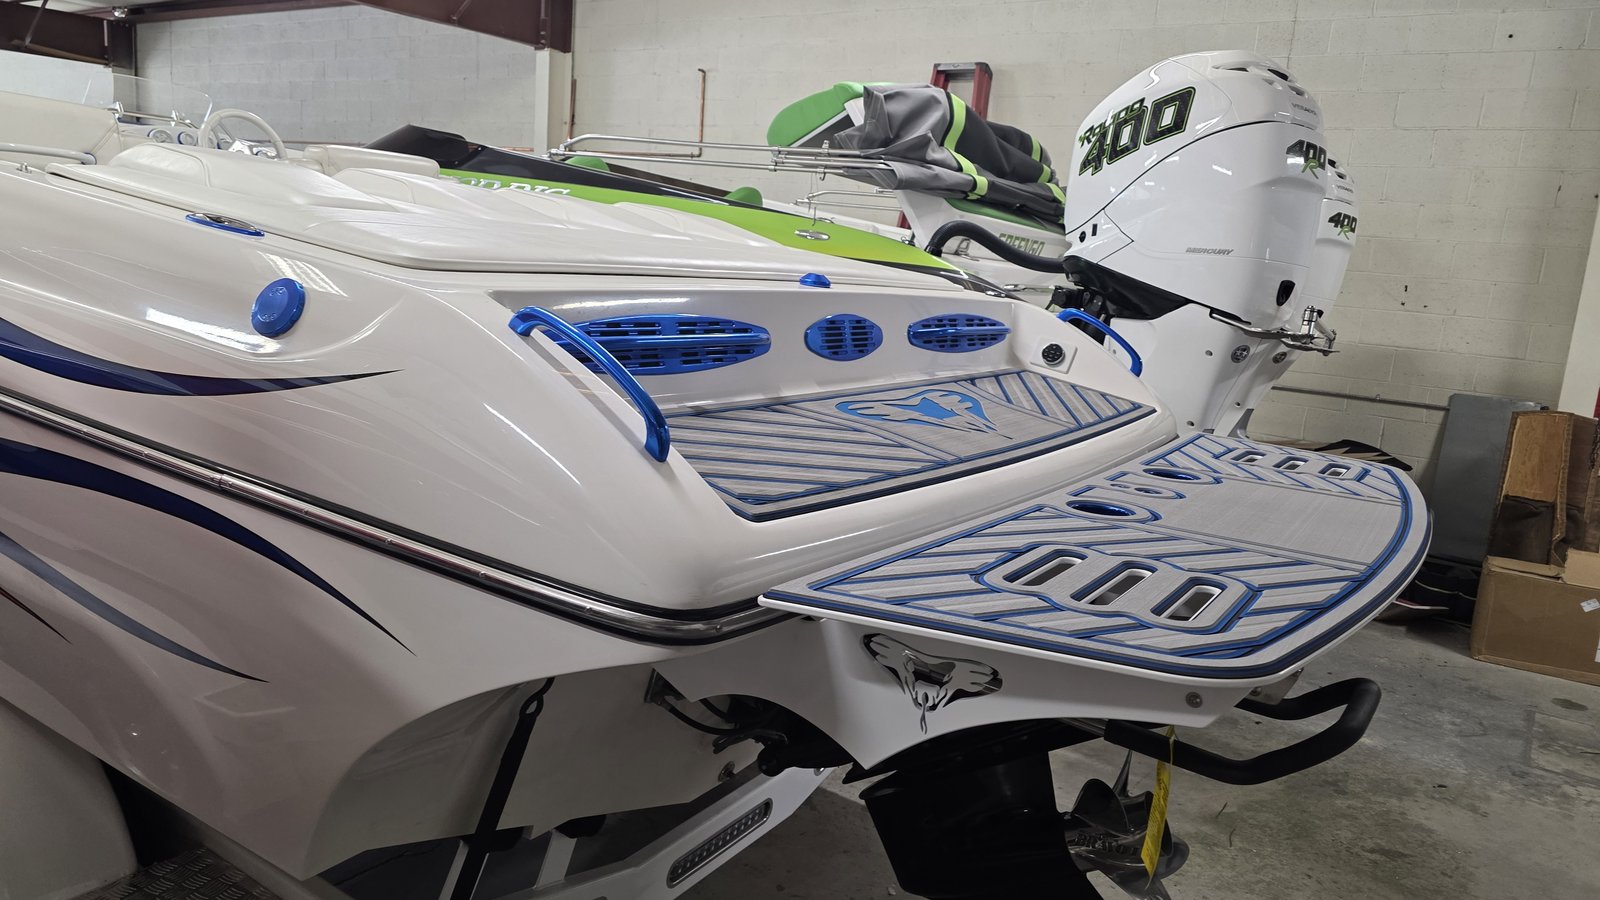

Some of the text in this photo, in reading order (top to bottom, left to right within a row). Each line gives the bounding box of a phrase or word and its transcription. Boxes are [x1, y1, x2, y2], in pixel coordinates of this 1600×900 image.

[1079, 86, 1197, 176] 400
[1328, 211, 1358, 233] 400
[1185, 246, 1235, 256] MERCURY
